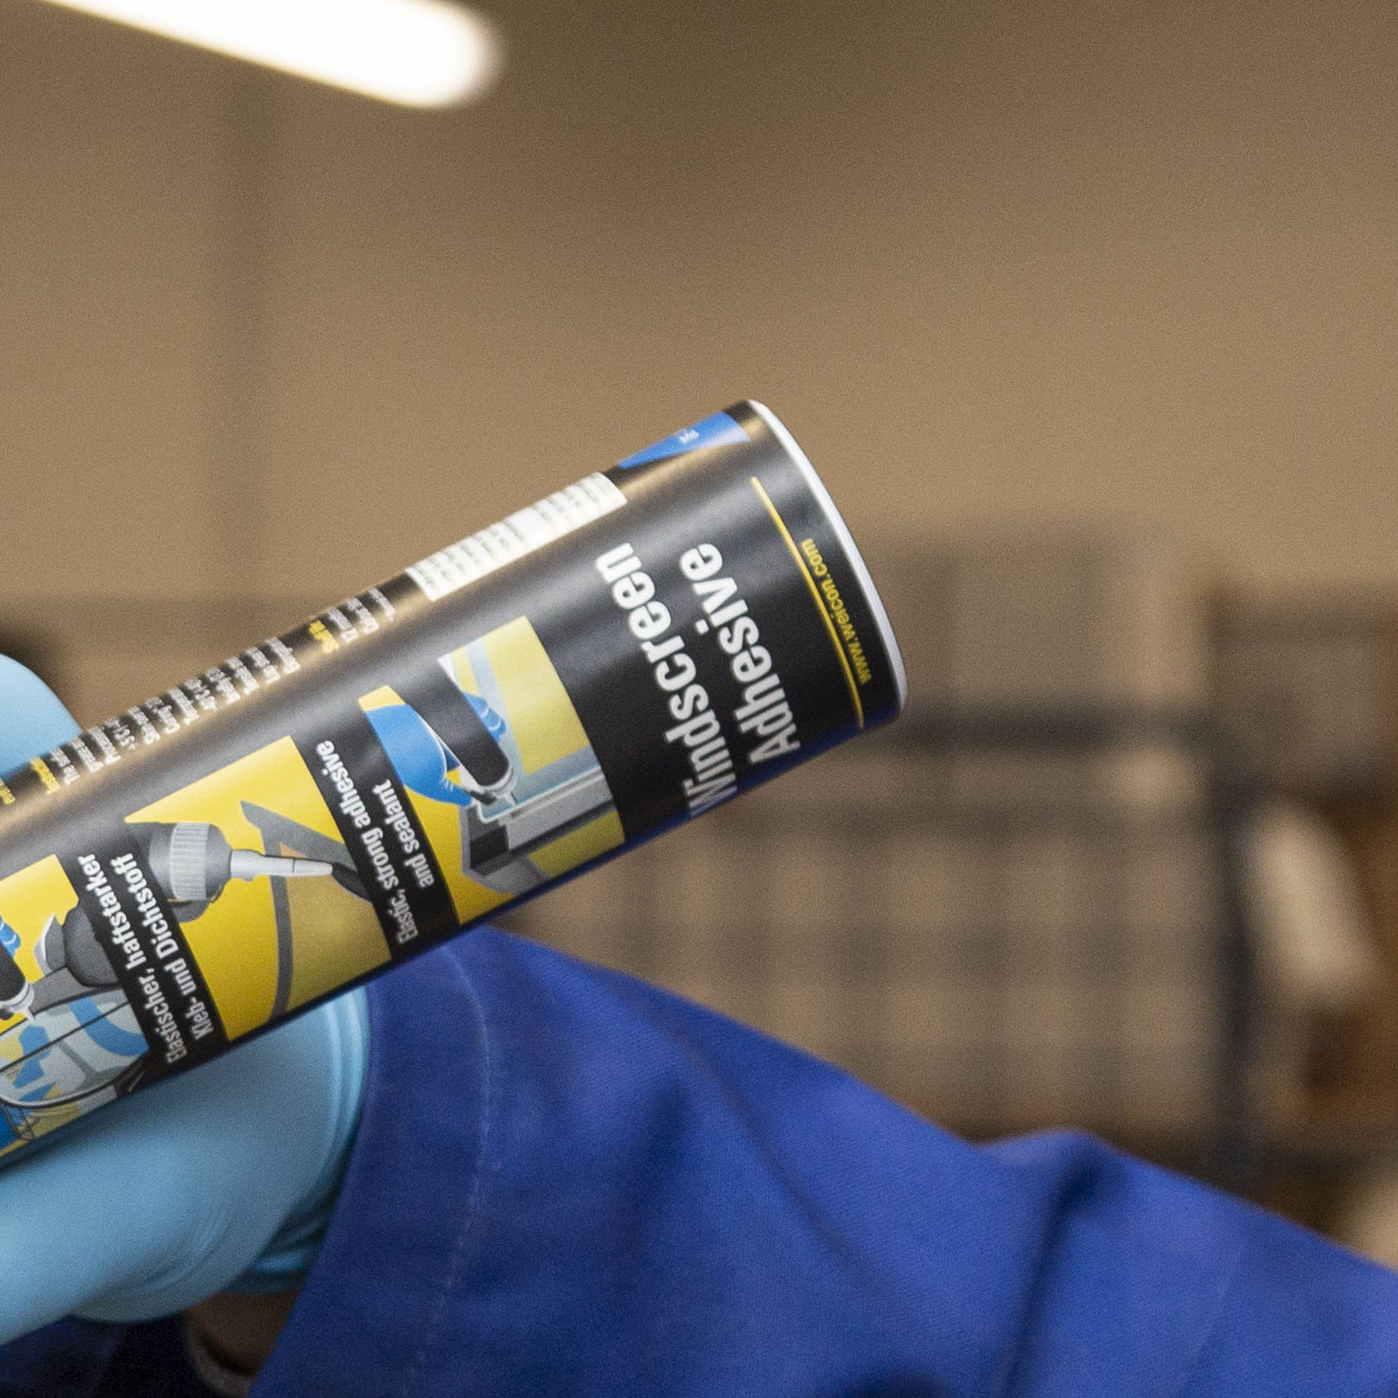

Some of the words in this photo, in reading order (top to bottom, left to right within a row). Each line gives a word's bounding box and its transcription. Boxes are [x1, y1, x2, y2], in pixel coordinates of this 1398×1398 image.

[674, 538, 801, 767] Adhesive
[798, 536, 872, 685] www.weicon.com
[590, 540, 735, 818] Windscreen
[314, 738, 372, 830] adhesive
[370, 778, 421, 855] sealant
[109, 850, 179, 958] Dichtstoff
[359, 825, 400, 892] strong
[403, 851, 435, 890] and
[76, 850, 147, 970] haftstarker
[137, 966, 188, 1064] Elastischer,
[164, 956, 197, 997] und
[184, 995, 214, 1041] Kleb-
